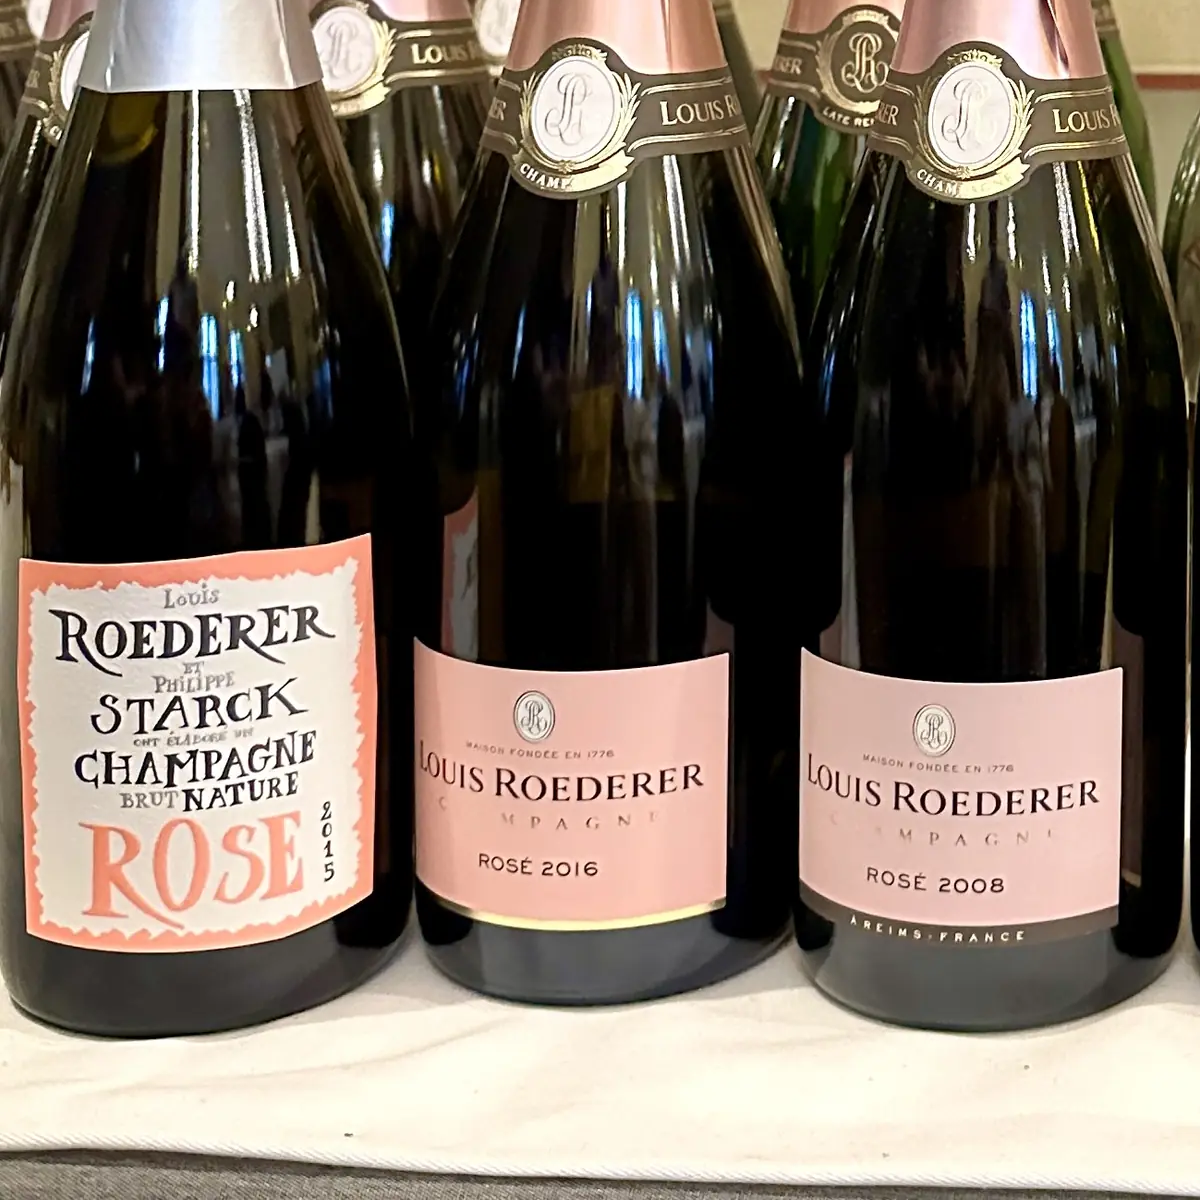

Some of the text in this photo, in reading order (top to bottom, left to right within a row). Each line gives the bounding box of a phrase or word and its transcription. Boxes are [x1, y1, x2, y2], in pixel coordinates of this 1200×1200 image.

[659, 98, 724, 127] LOUIS
[1052, 108, 1111, 134] LOUIS
[520, 162, 573, 191] CHAMP
[916, 168, 1015, 197] CHAMAGNE
[48, 604, 337, 677] ROEDERER
[182, 661, 204, 675] ET
[90, 677, 310, 736] STARCK
[74, 730, 318, 791] CHAMPAGNE
[465, 740, 505, 754] MAISON
[565, 751, 582, 760] EN
[587, 749, 615, 759] 1776
[862, 753, 1015, 775] MAISON FONDÉE EN 1776
[419, 740, 705, 803] LOUIS ROEDERER
[806, 752, 1101, 818] LOUIS ROEDERER
[119, 770, 300, 813] BRUT NATURE
[319, 800, 336, 883] 2015
[478, 852, 600, 878] ROSÉ 2016
[866, 866, 1006, 895] ROSÉ 2008
[939, 930, 1025, 943] FRANCE
